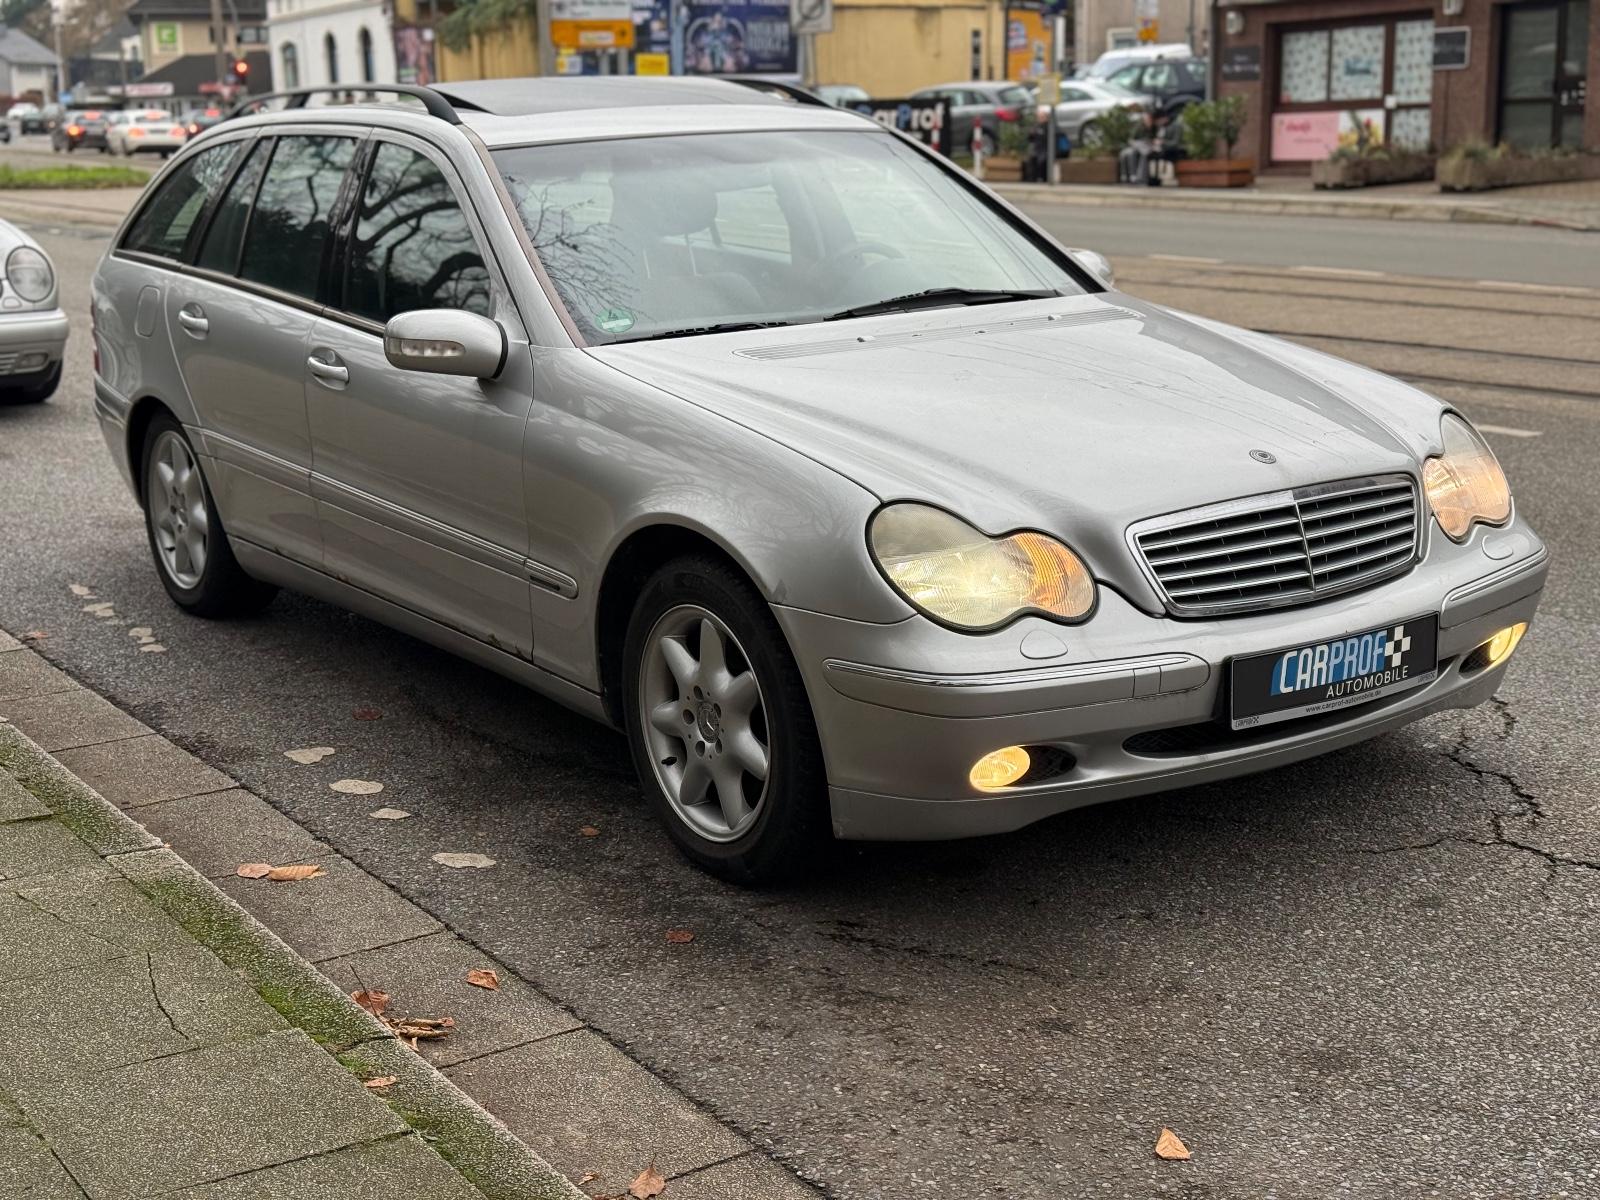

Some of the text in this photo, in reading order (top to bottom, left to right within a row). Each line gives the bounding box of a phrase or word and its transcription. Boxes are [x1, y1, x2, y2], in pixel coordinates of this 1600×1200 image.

[1280, 630, 1387, 693] CARPROF
[1326, 665, 1409, 698] AUTOMOBILE
[1306, 690, 1382, 713] www.carprof-automobile.de
